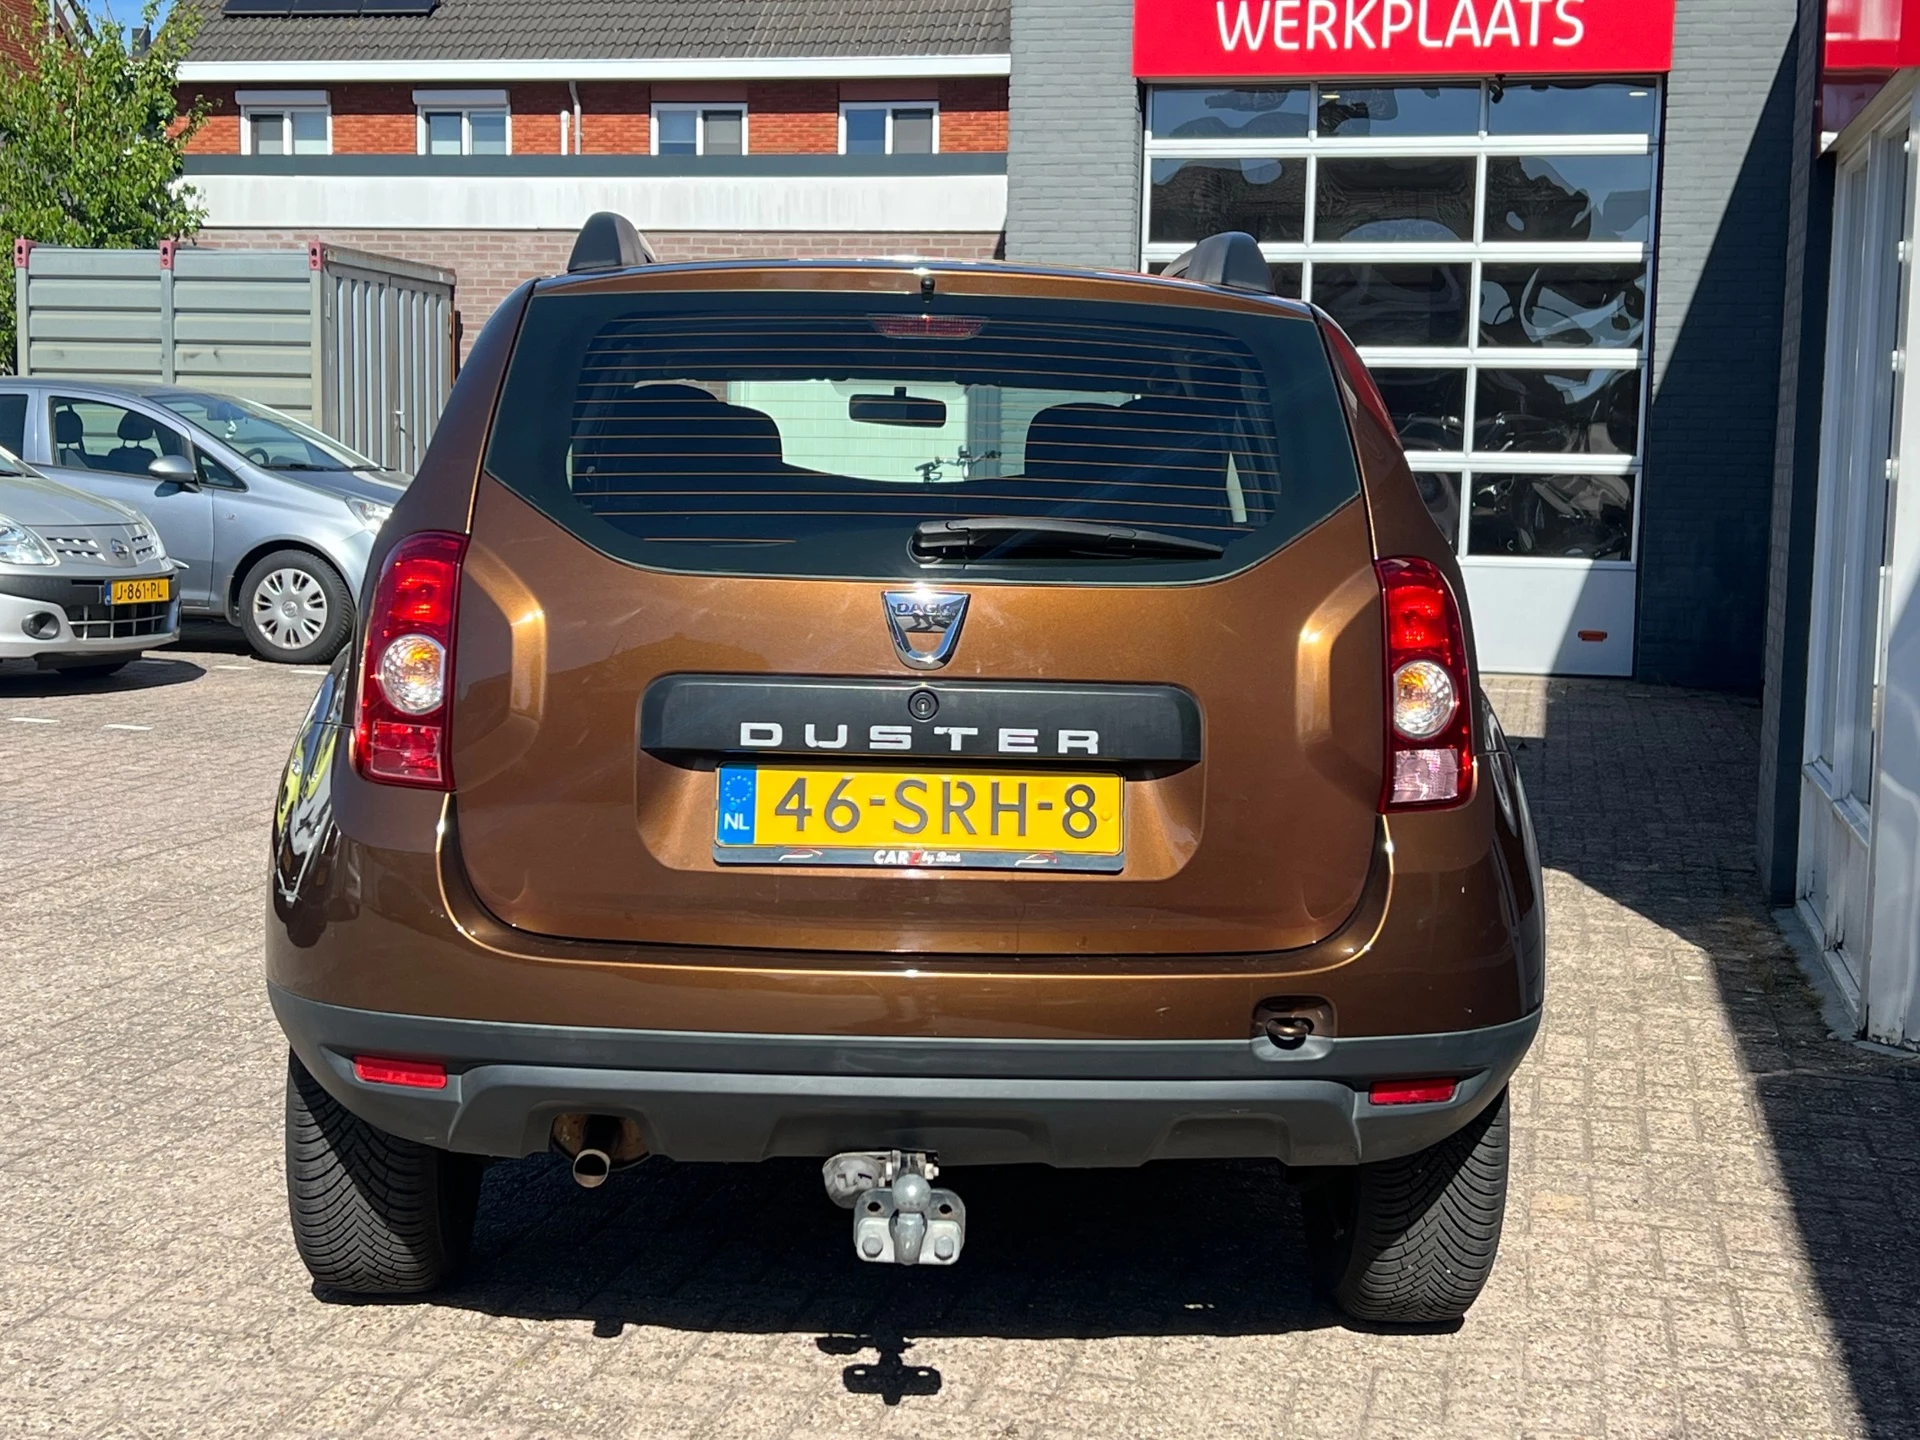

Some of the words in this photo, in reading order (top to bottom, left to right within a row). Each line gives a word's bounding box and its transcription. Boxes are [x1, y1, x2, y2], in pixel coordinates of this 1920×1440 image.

[1216, 0, 1585, 50] WERKPLAATS
[116, 582, 163, 600] J-861-PL
[740, 722, 1099, 755] DUSTER
[723, 812, 750, 830] NL
[774, 777, 1097, 840] 46-SRH-8
